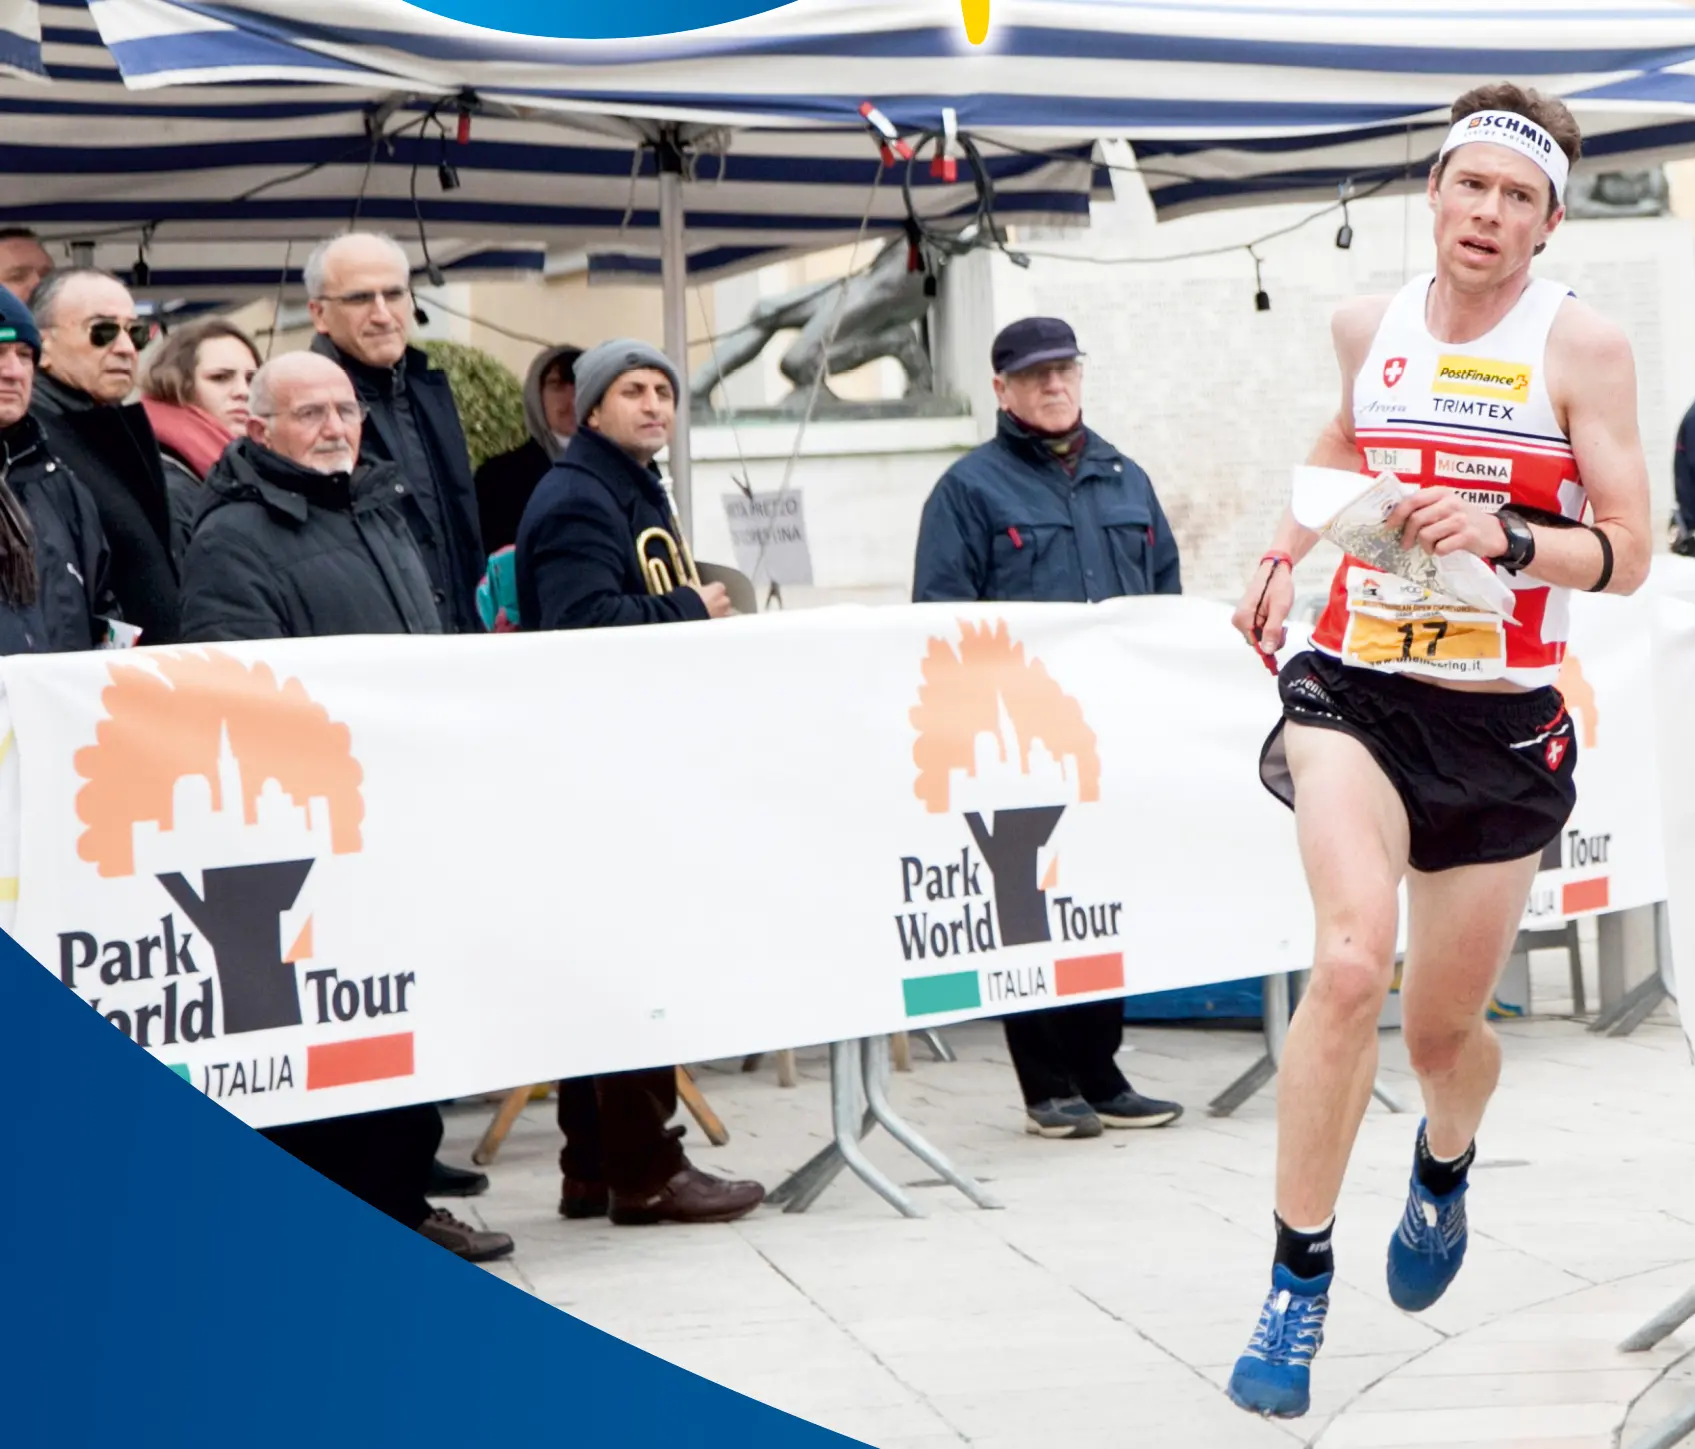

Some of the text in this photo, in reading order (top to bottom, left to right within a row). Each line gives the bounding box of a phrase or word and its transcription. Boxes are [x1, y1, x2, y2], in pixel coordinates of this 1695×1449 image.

[1483, 115, 1552, 154] SCHMID
[1440, 367, 1514, 386] PostFinance
[1433, 397, 1514, 421] TRIMTEX
[1438, 459, 1509, 478] MICARNA
[1455, 491, 1505, 505] CHMID
[1397, 621, 1448, 658] 17
[1567, 829, 1611, 868] Tour
[900, 846, 983, 903] Park
[895, 896, 1123, 961] World Tour
[57, 912, 200, 989] Park
[987, 967, 1048, 1001] ITALIA
[93, 968, 415, 1048] orld Tour
[203, 1054, 294, 1098] ITALIA
